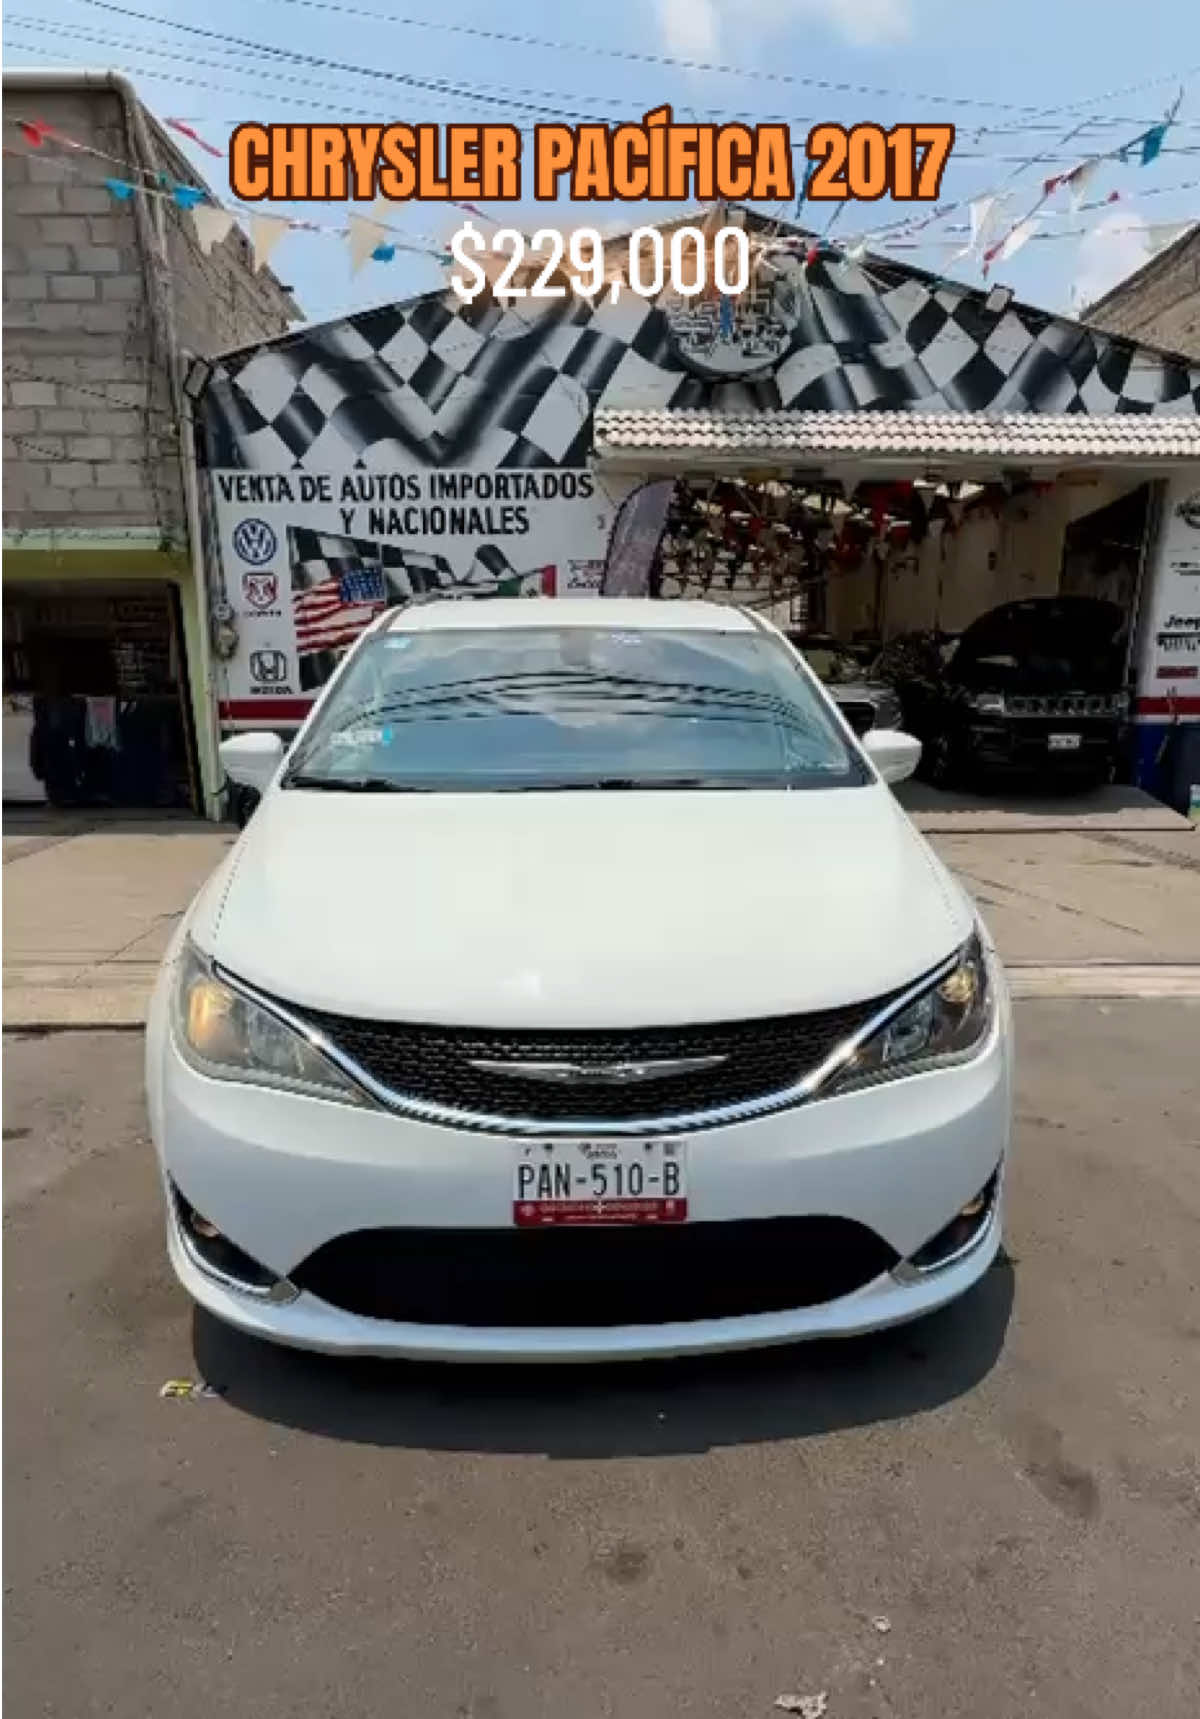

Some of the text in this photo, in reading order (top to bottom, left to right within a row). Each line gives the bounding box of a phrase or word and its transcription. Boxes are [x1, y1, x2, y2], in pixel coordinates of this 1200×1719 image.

[218, 473, 594, 502] VENTA DE AUTOS IMPORTADOS
[340, 506, 530, 535] Y NACIONALES
[517, 1161, 680, 1199] PAN-510-B
